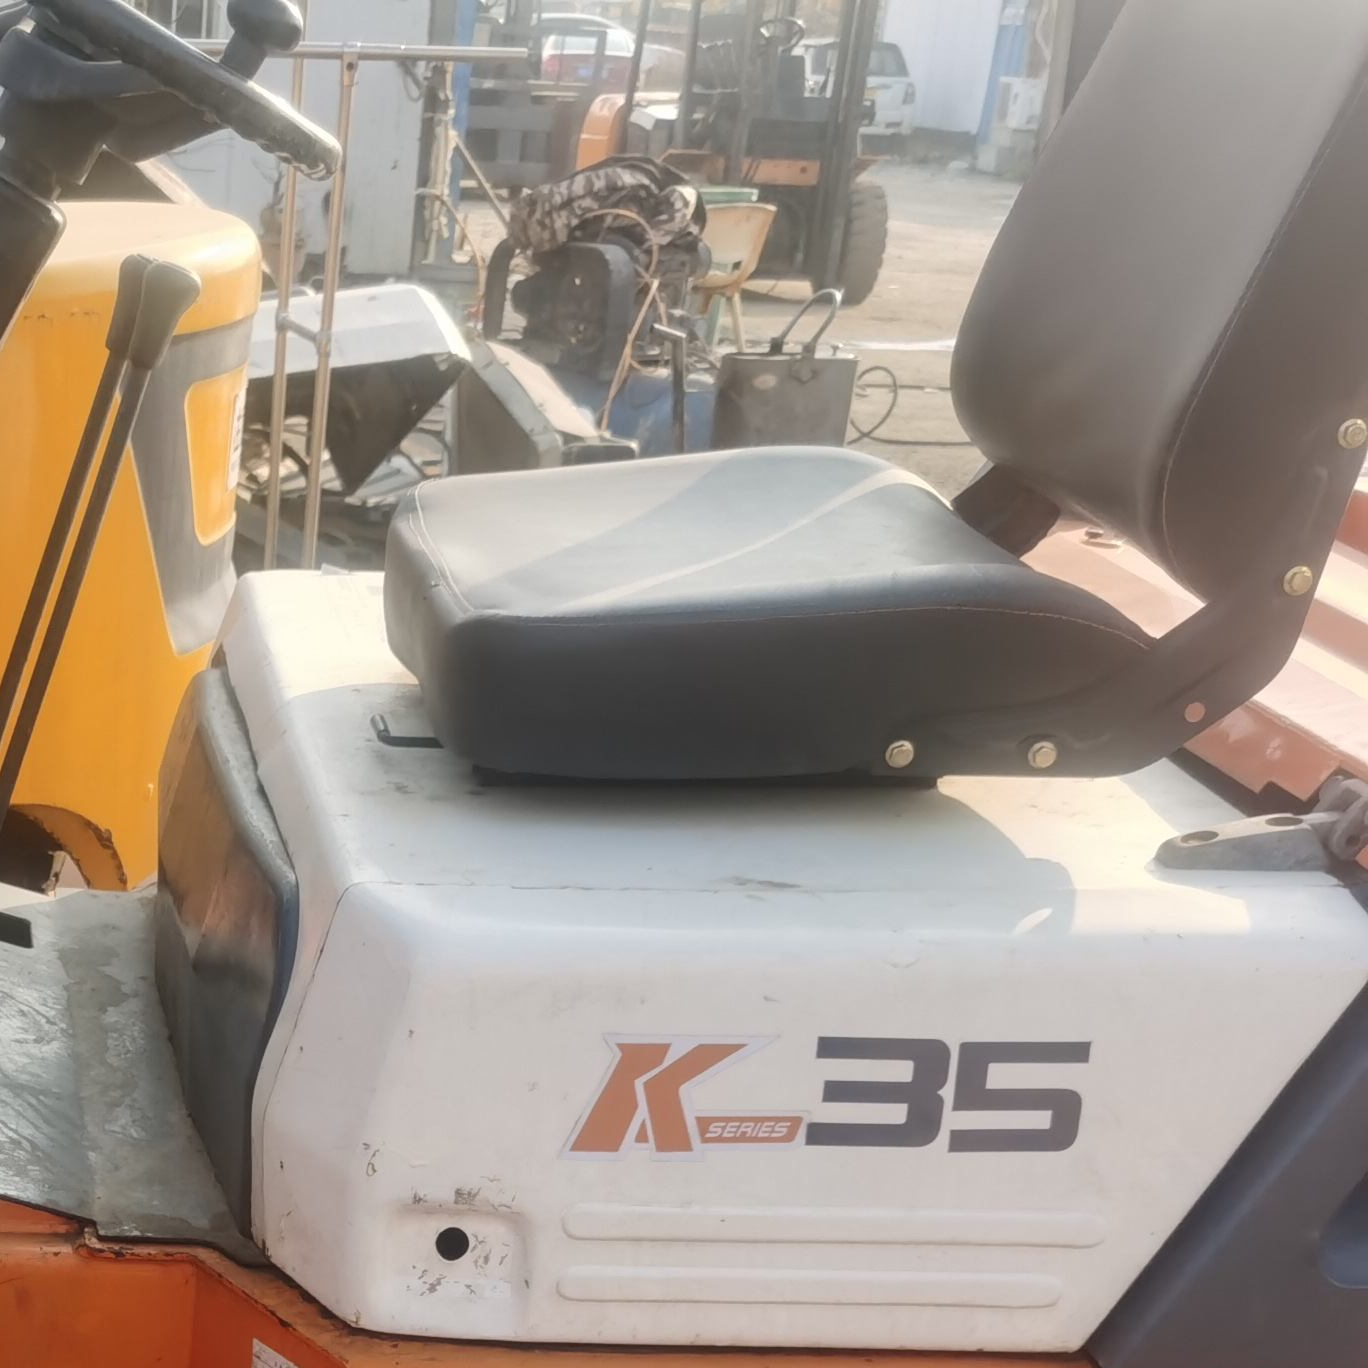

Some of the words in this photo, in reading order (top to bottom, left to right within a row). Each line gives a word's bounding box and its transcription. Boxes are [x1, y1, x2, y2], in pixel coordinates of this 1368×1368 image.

[569, 1042, 748, 1153] K
[704, 1121, 792, 1138] SERIES
[805, 1036, 1091, 1153] 35
